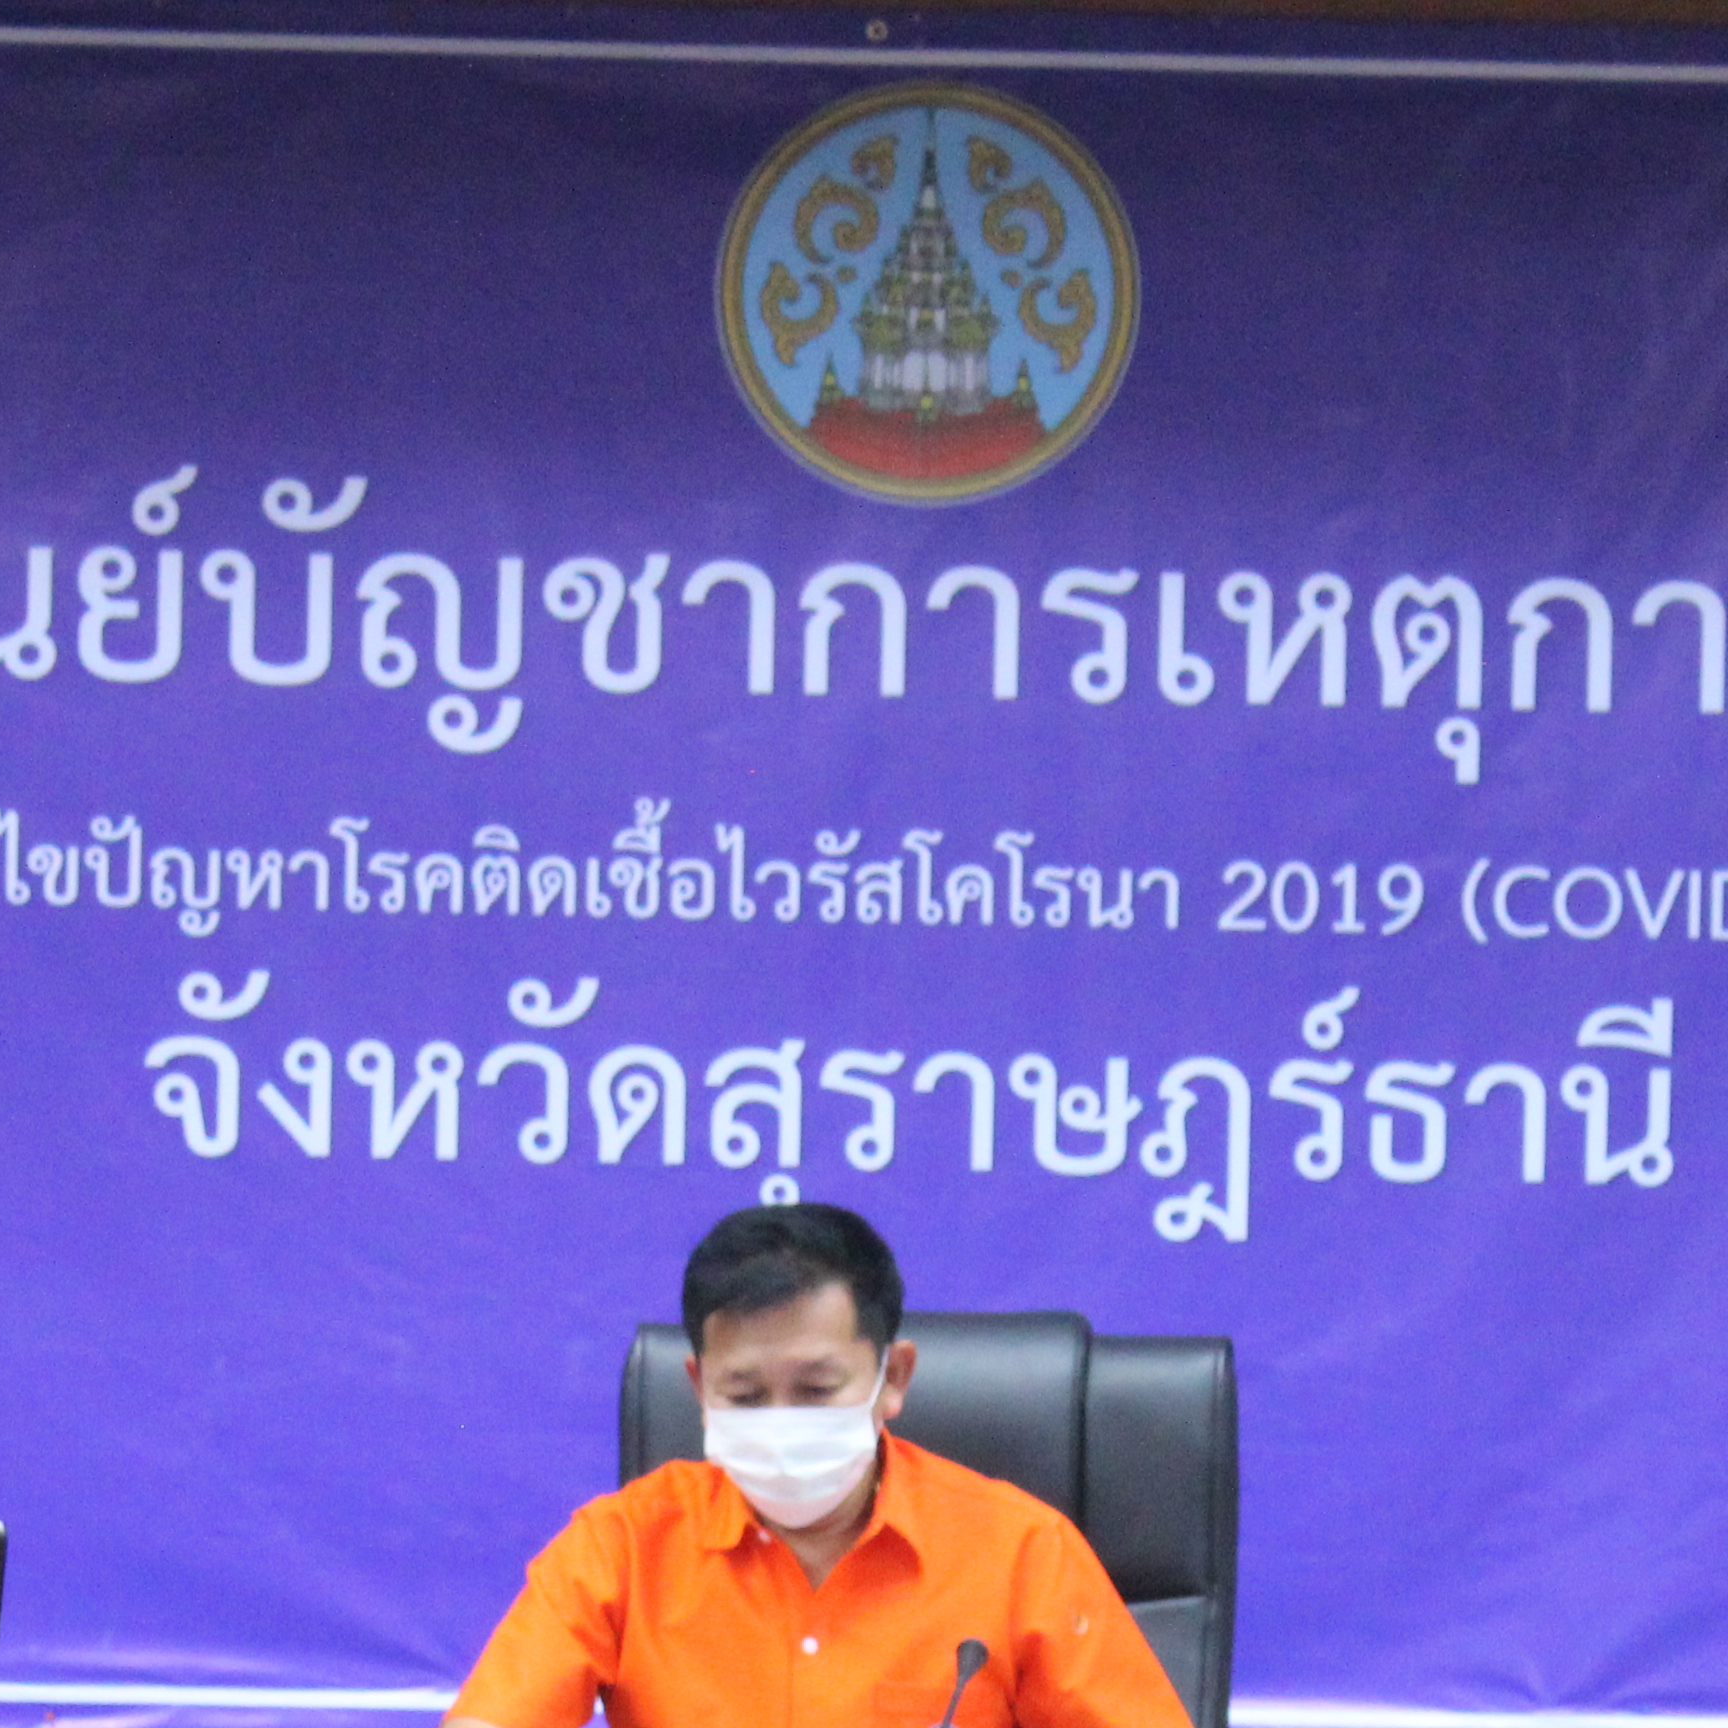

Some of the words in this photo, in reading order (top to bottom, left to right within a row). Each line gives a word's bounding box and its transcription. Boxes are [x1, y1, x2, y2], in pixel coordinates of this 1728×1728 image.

[1217, 859, 1424, 936] 2019
[143, 969, 1675, 1242] จังหวัดสุราษฎร์ธานี
